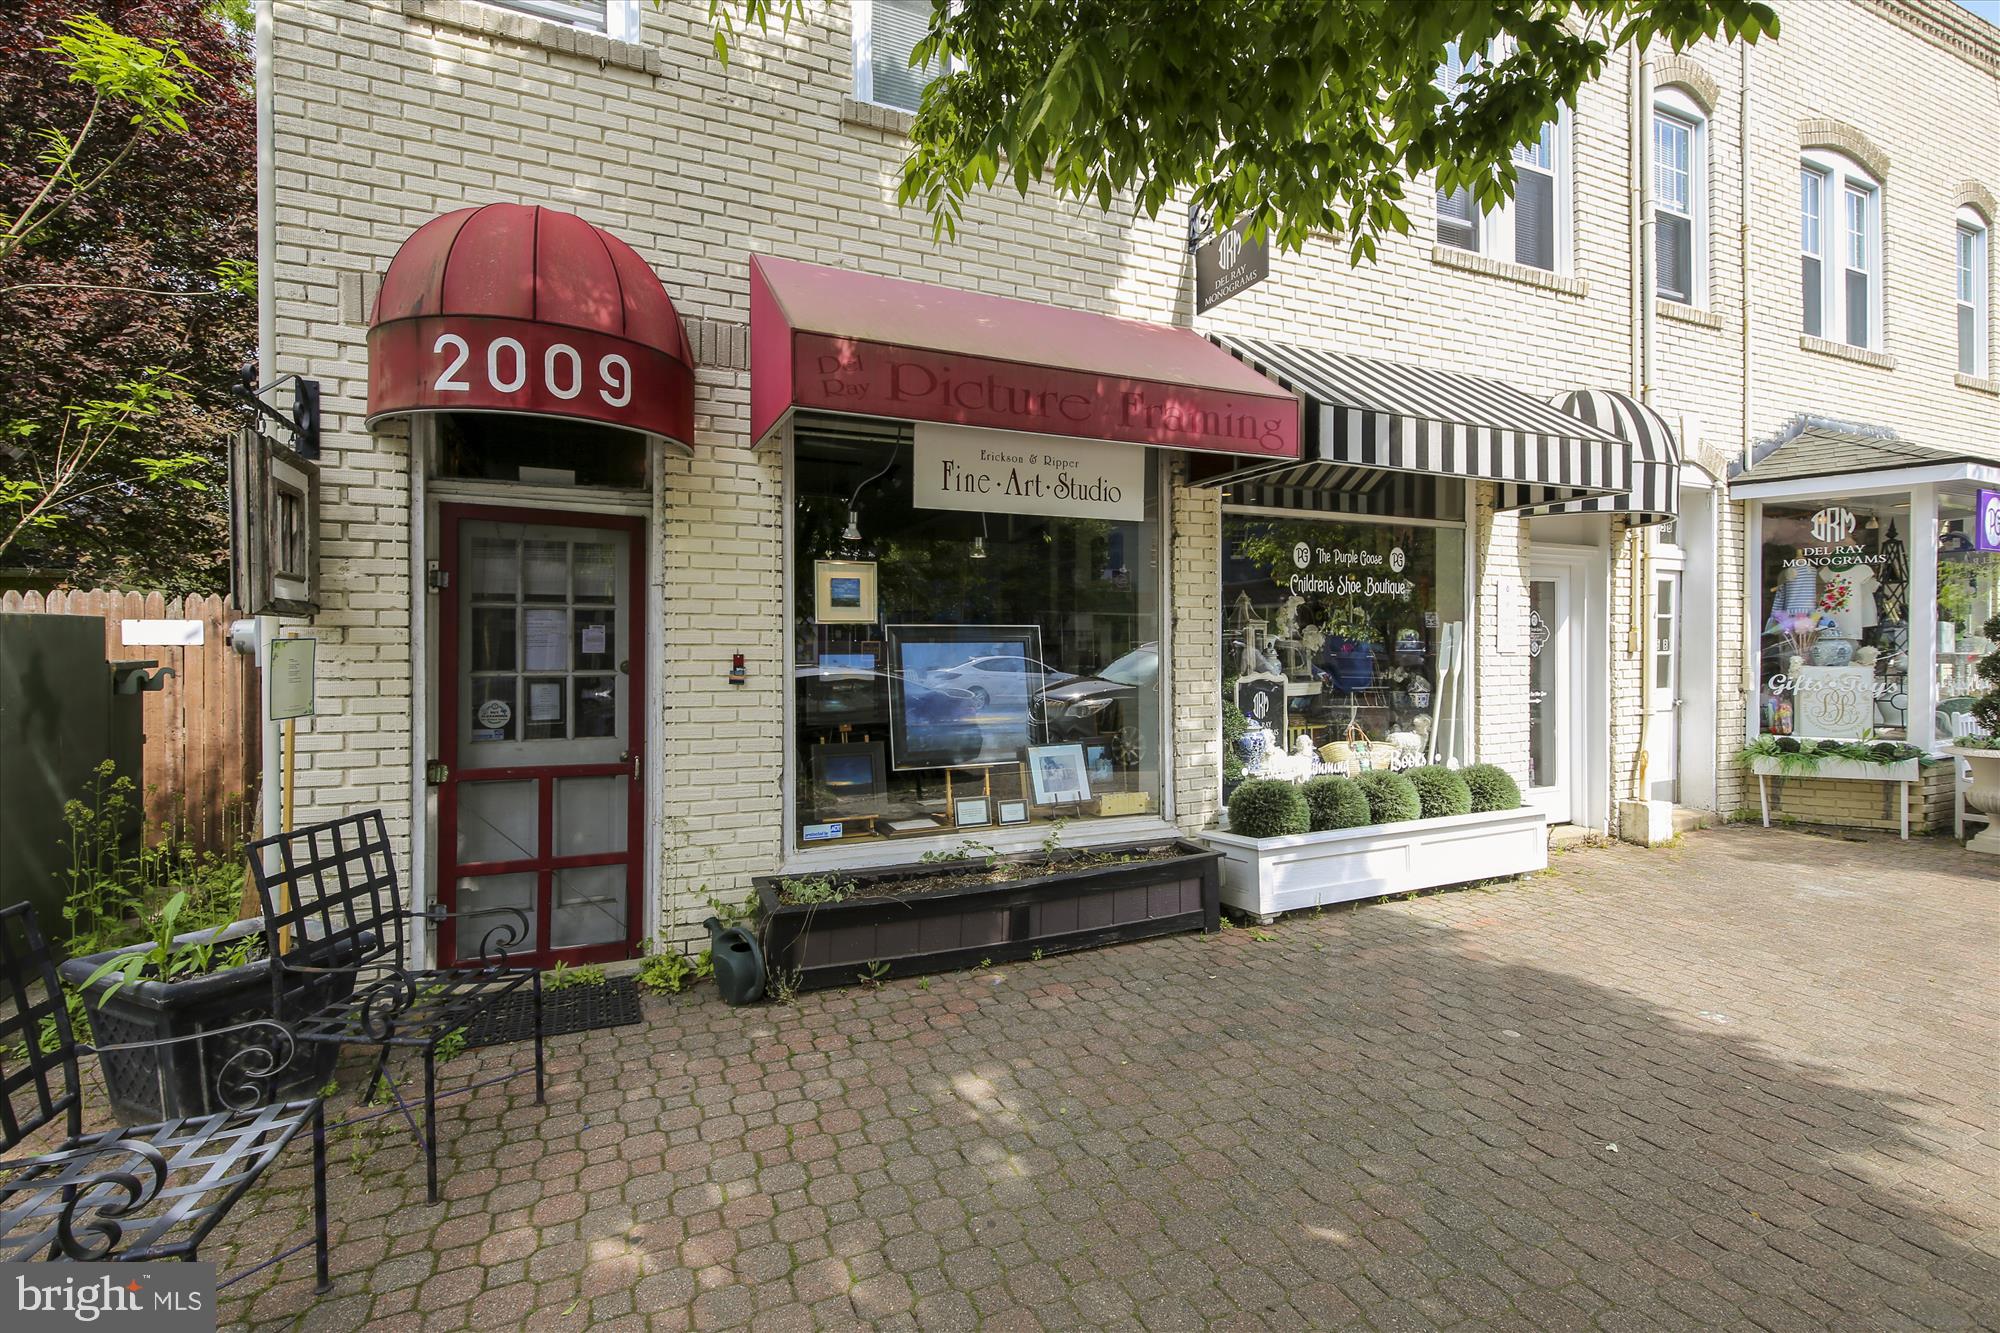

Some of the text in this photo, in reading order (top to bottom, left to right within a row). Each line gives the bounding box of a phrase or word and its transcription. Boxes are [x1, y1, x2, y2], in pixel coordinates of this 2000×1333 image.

[1204, 269, 1258, 307] MONOGRAMS
[1215, 264, 1247, 289] DEL RAY
[433, 333, 632, 407] 2009
[818, 355, 864, 374] Del
[822, 379, 870, 400] Ray
[885, 360, 1285, 451] Picture Framing
[980, 449, 1080, 469] Erickson & Ripper
[941, 460, 1122, 503] Fine Art Studio
[1315, 547, 1331, 564] The
[1333, 548, 1359, 568] Purple
[1359, 550, 1383, 566] Goose
[1783, 554, 1888, 568] MONOGRAMS
[1804, 544, 1866, 556] DEL RAY
[1290, 573, 1406, 600] Children's Shoe Boutique
[1768, 674, 1899, 699] Gifts Toys
